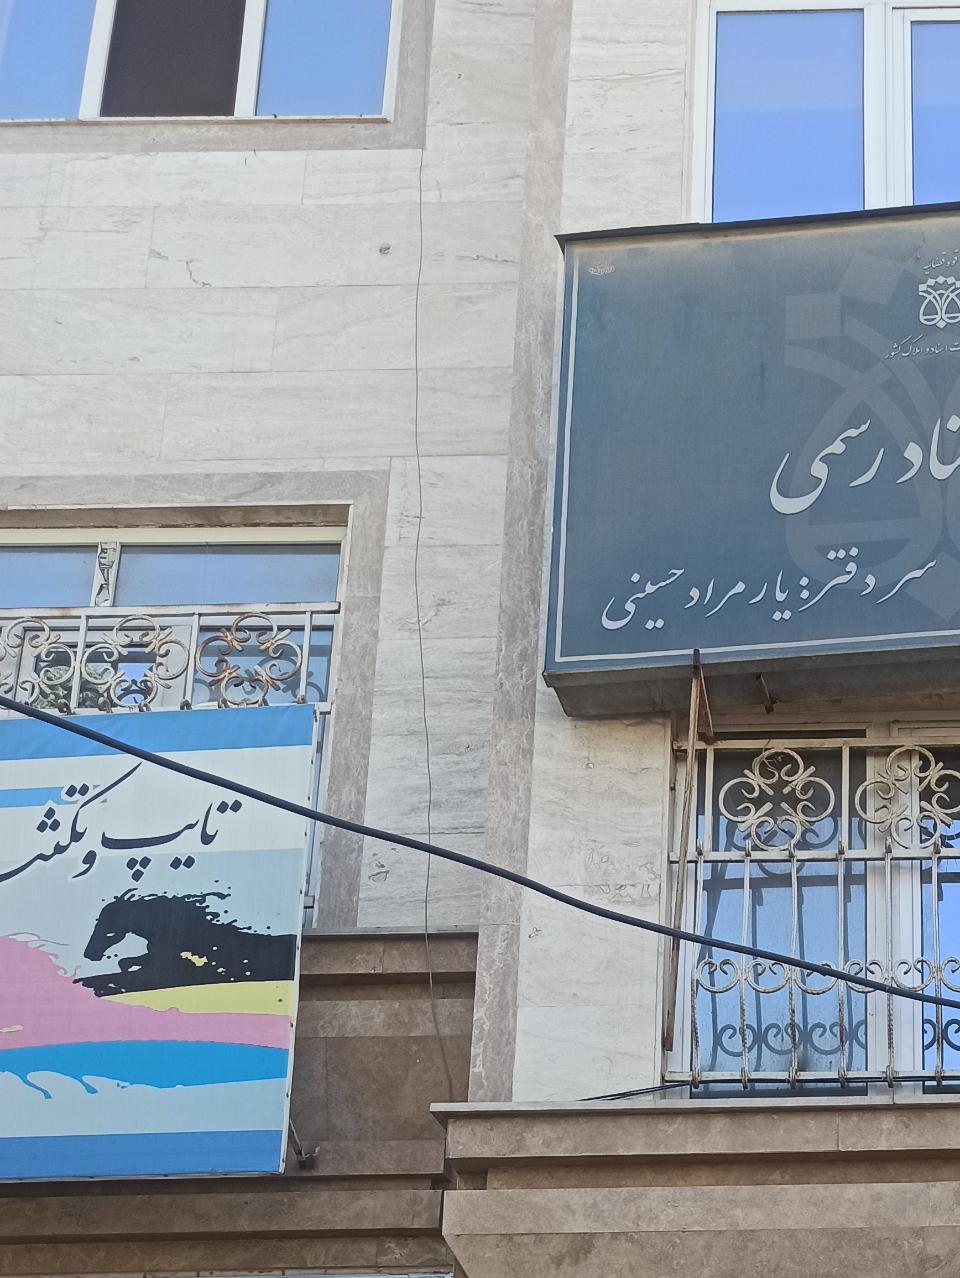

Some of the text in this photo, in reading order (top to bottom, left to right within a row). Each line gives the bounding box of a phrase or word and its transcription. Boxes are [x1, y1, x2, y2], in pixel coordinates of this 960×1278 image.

[884, 334, 913, 359] کشور
[901, 334, 923, 357] املاک
[931, 342, 948, 354] اسناد
[769, 419, 884, 514] رسمی
[600, 567, 685, 631] حسینی
[101, 799, 243, 883] تایپ
[71, 849, 98, 879] و
